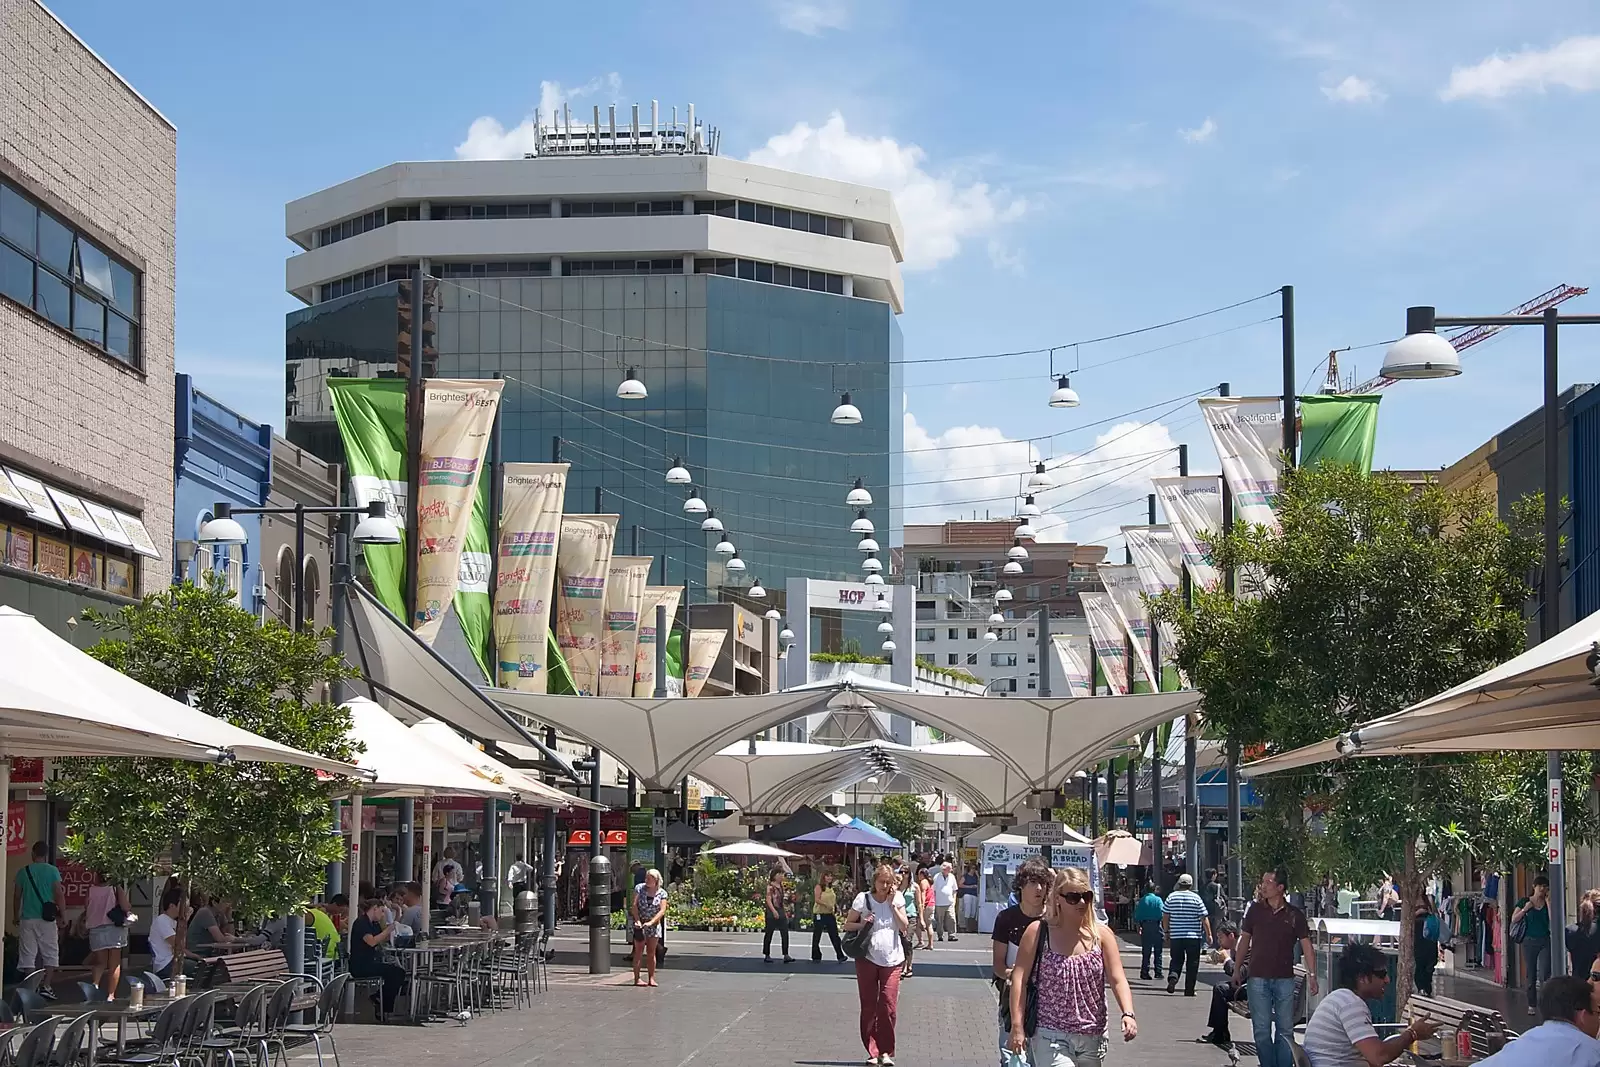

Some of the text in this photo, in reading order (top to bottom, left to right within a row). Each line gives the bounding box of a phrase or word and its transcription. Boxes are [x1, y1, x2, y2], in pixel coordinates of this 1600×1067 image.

[429, 393, 469, 403] Brightest
[475, 399, 494, 407] BEST
[432, 461, 444, 469] BJ
[507, 476, 540, 486] Brightest
[564, 526, 593, 535] Brightest
[513, 535, 524, 543] BJ
[1060, 855, 1088, 863] BREAD
